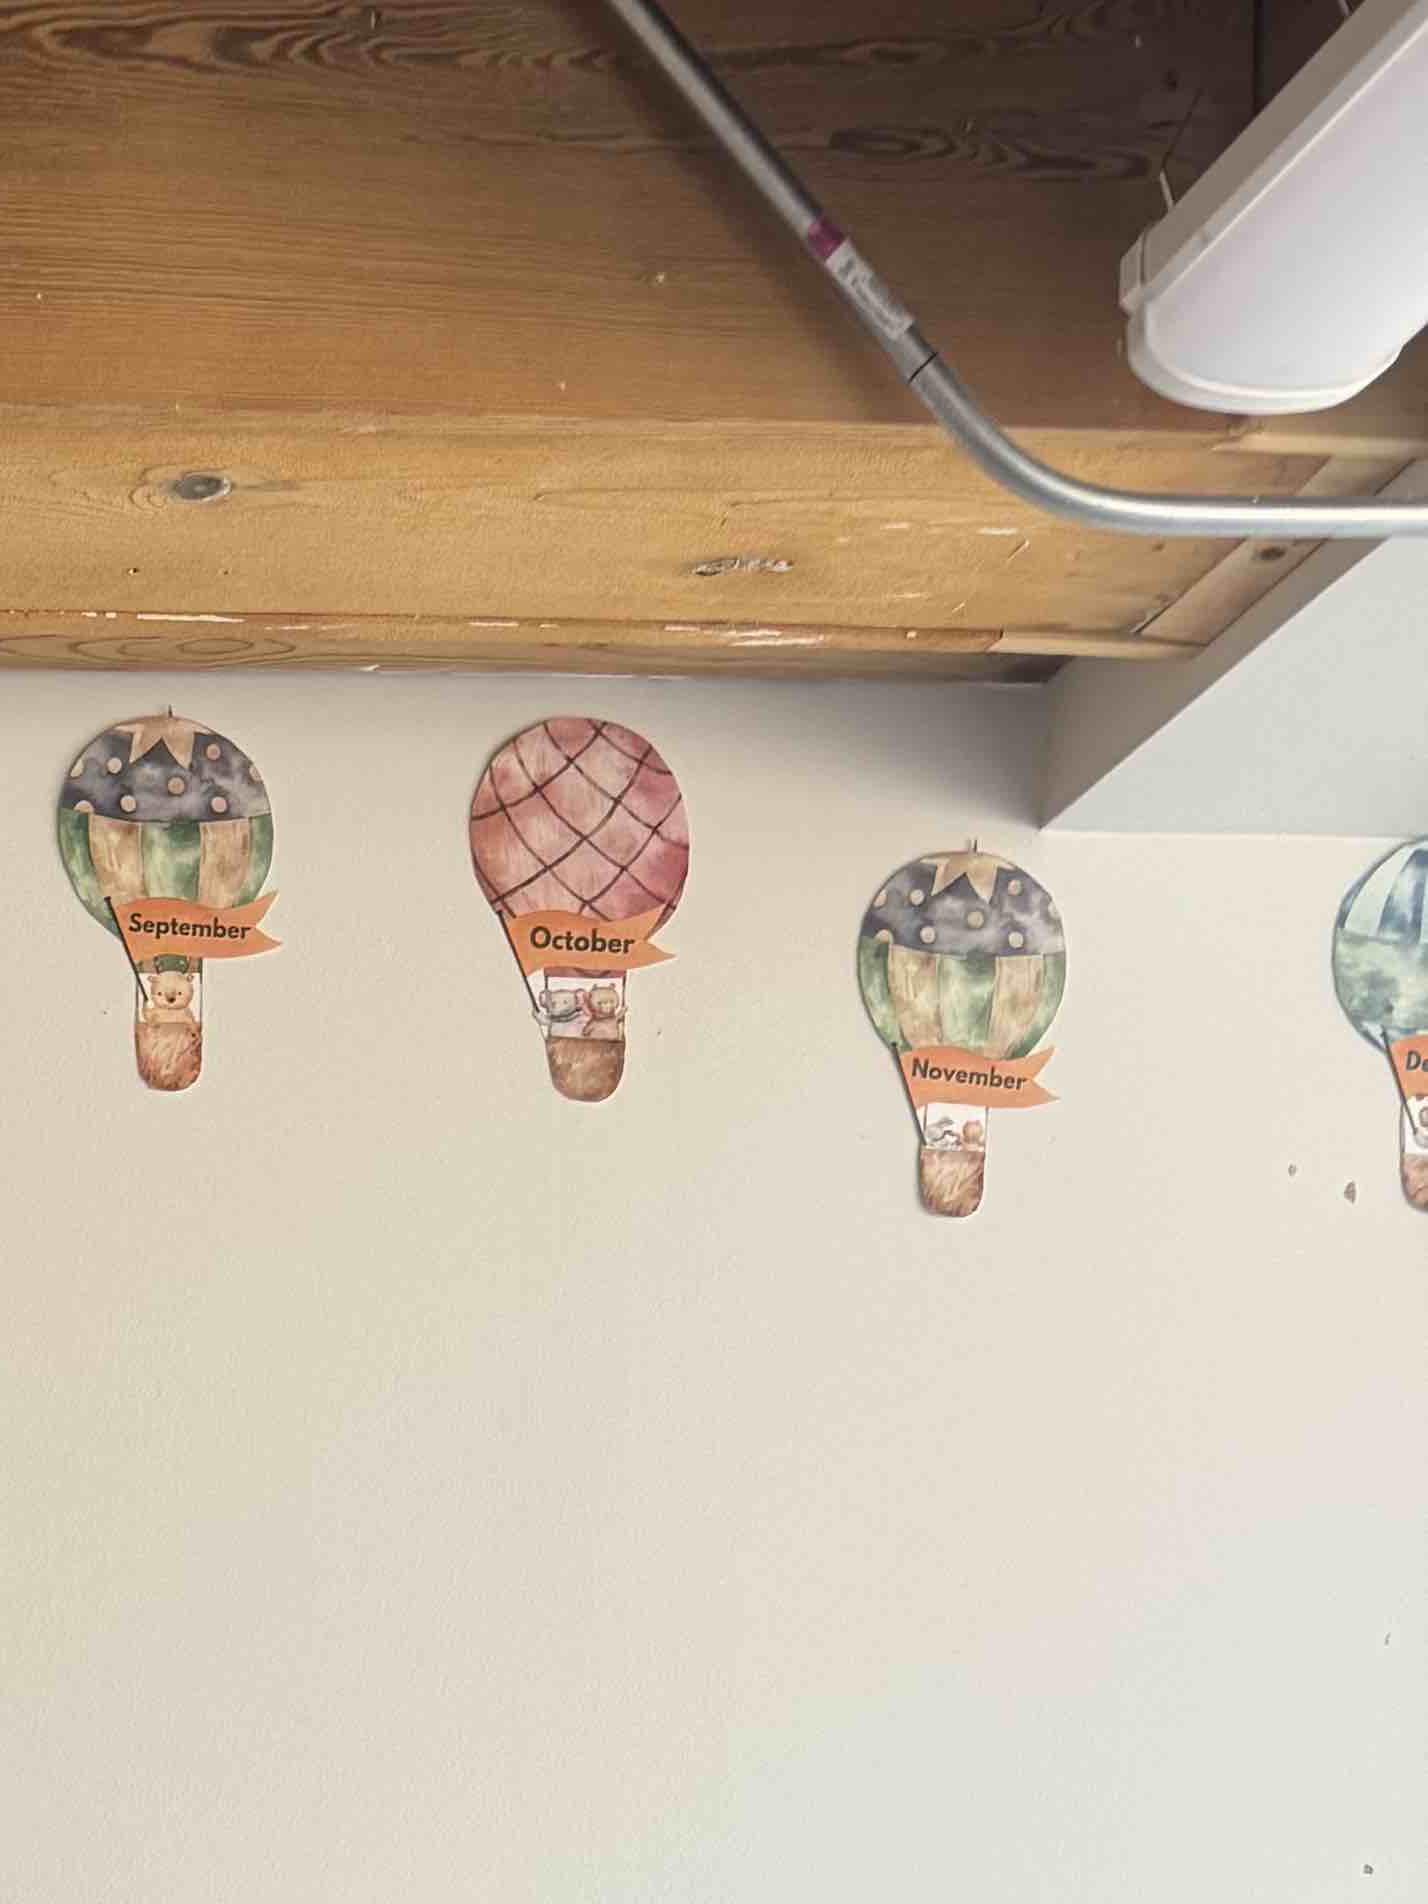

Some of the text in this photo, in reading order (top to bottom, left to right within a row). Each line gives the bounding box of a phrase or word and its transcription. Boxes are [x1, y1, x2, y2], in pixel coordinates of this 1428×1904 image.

[128, 912, 251, 941] September
[529, 925, 635, 954] October
[911, 1056, 1027, 1091] November
